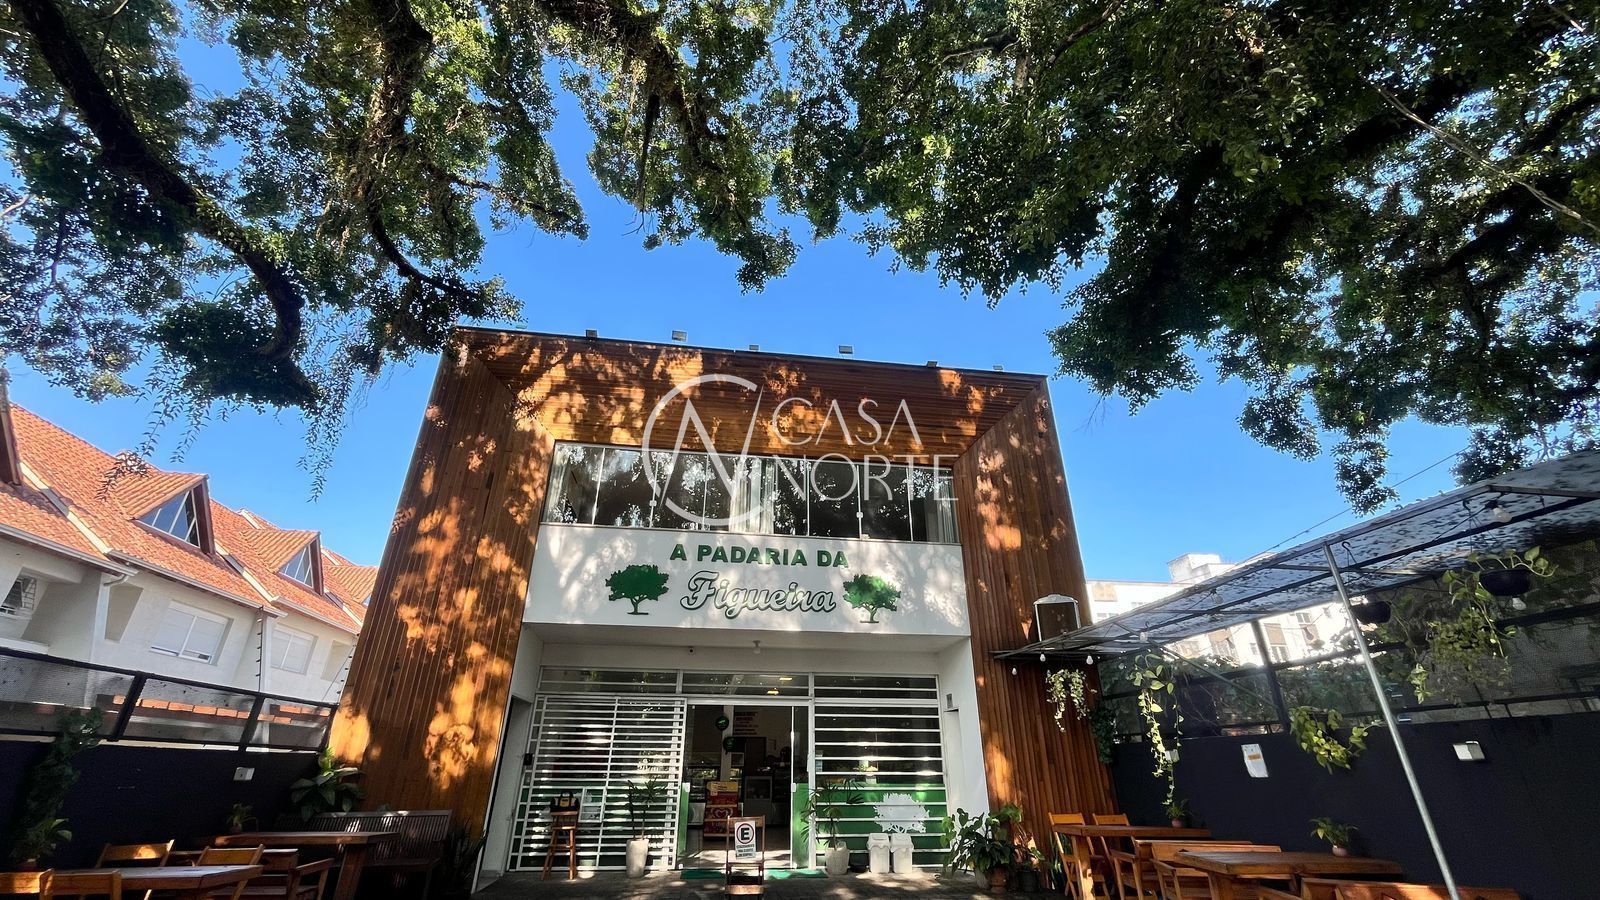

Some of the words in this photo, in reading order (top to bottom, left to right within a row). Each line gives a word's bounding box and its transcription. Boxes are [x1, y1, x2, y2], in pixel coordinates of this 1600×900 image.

[669, 543, 688, 562] A
[697, 544, 808, 567] PADARIA
[816, 550, 849, 568] DA
[679, 570, 837, 619] Figueira
[740, 827, 750, 840] E
